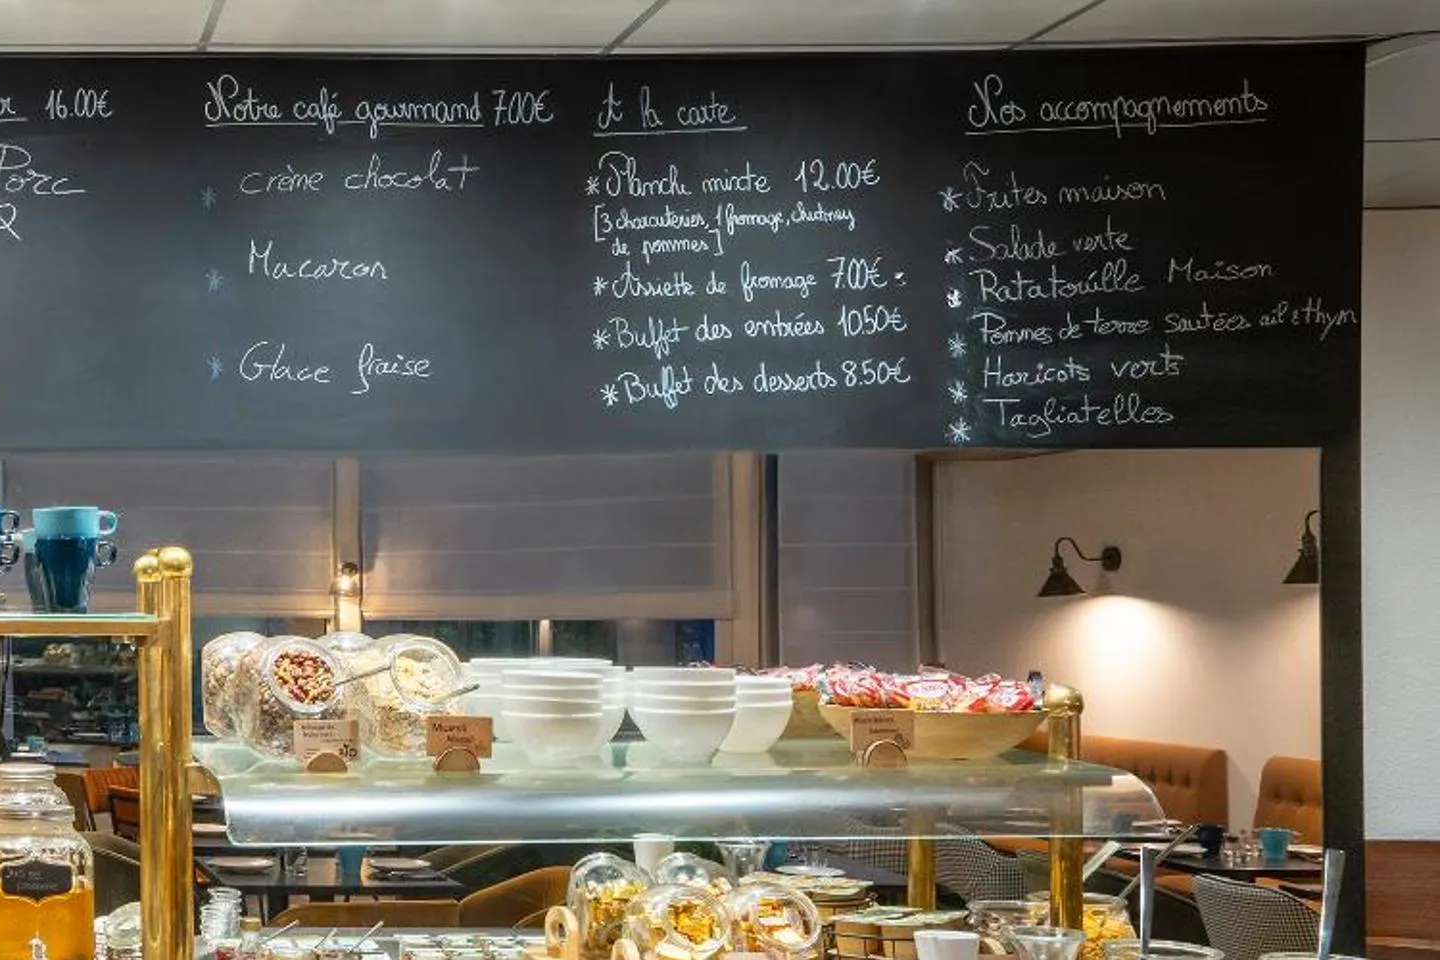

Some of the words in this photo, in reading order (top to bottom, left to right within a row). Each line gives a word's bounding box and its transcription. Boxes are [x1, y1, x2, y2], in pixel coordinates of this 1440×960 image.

[45, 89, 113, 121] 16.00€
[205, 74, 283, 122] Notre
[293, 86, 342, 134] café
[355, 91, 483, 139] gourmand
[640, 85, 663, 128] la
[677, 90, 737, 126] carte
[968, 74, 1027, 128] Nos
[1039, 78, 1269, 139] accompagnements
[240, 164, 324, 194] crème
[345, 149, 481, 191] chocolat
[598, 151, 692, 197] Planche
[794, 159, 881, 193] 12.00€
[962, 161, 1048, 212] Frites
[1060, 174, 1166, 203] maison
[611, 237, 631, 257] de
[969, 224, 1065, 260] Salade
[1072, 214, 1134, 252] verte
[248, 239, 388, 281] Macaron
[706, 270, 727, 295] de
[740, 261, 817, 302] fromage
[1168, 256, 1274, 283] Maison
[608, 315, 690, 360] Buffet
[695, 313, 732, 342] des
[744, 309, 826, 338] entrées
[971, 312, 1053, 347] Pommes
[1059, 320, 1083, 341] de
[1087, 306, 1152, 338] terre
[239, 341, 330, 384] Glace
[350, 342, 433, 394] fraise
[618, 364, 694, 410] Buffet
[704, 362, 744, 395] des
[753, 360, 837, 392] desserts
[840, 356, 911, 388] 8.50€
[984, 356, 1091, 388] Haricots
[1110, 345, 1185, 380] verts
[983, 393, 1175, 438] Tagliatelles
